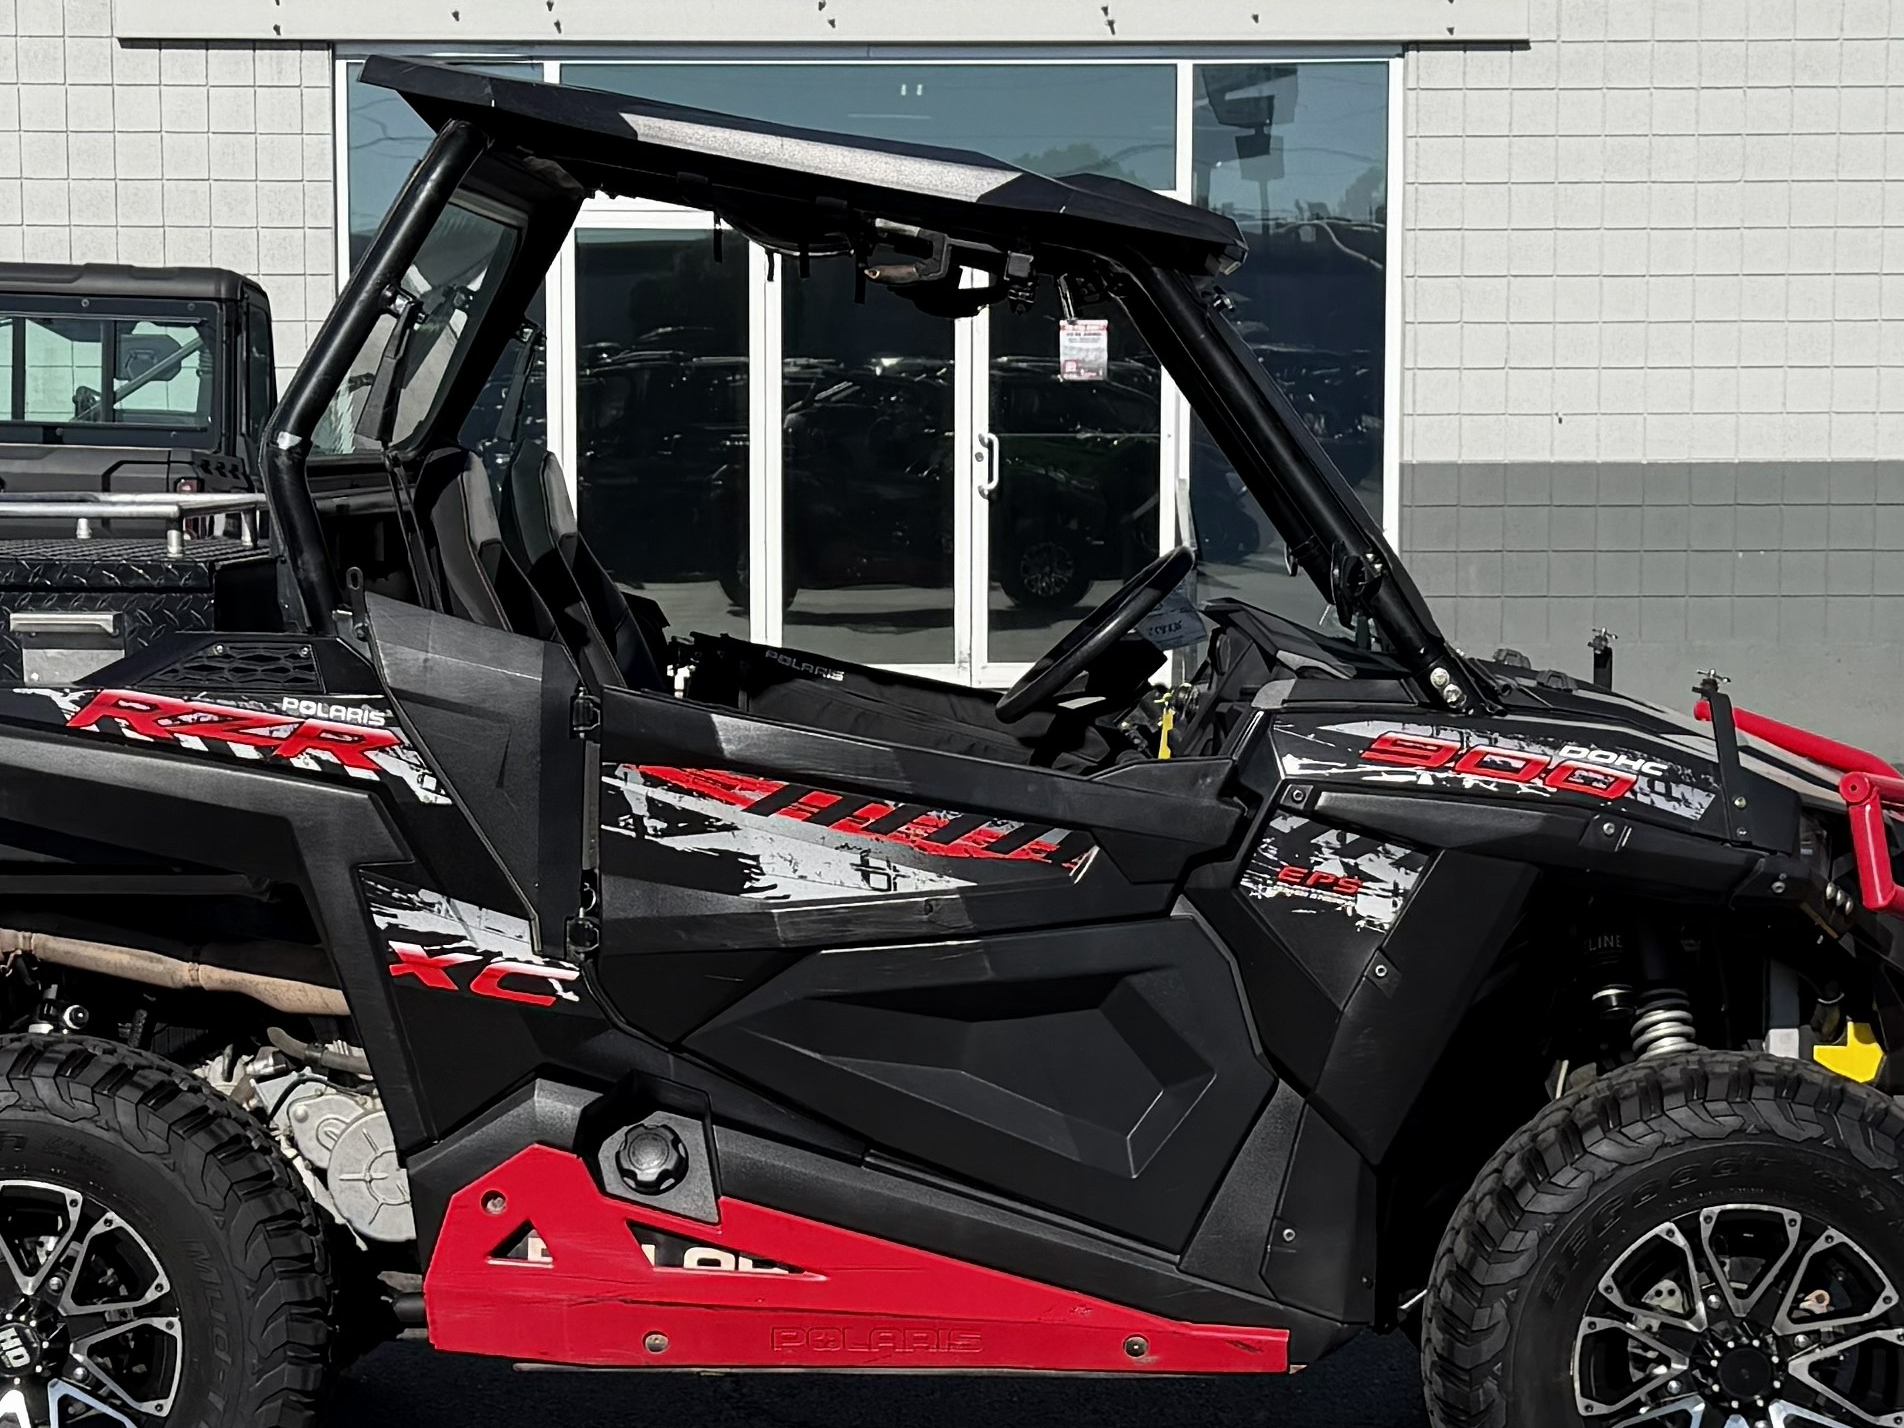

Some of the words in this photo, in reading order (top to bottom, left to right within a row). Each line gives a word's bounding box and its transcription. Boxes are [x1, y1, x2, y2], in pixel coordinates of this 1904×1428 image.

[765, 649, 845, 682] POLARIS
[281, 695, 388, 728] POLARIS
[64, 688, 403, 771] RZR
[1360, 730, 1639, 801] 900
[1558, 744, 1669, 777] DOHC
[1276, 864, 1364, 896] EPS
[389, 942, 580, 1008] XC
[770, 1326, 984, 1353] POLARIS
